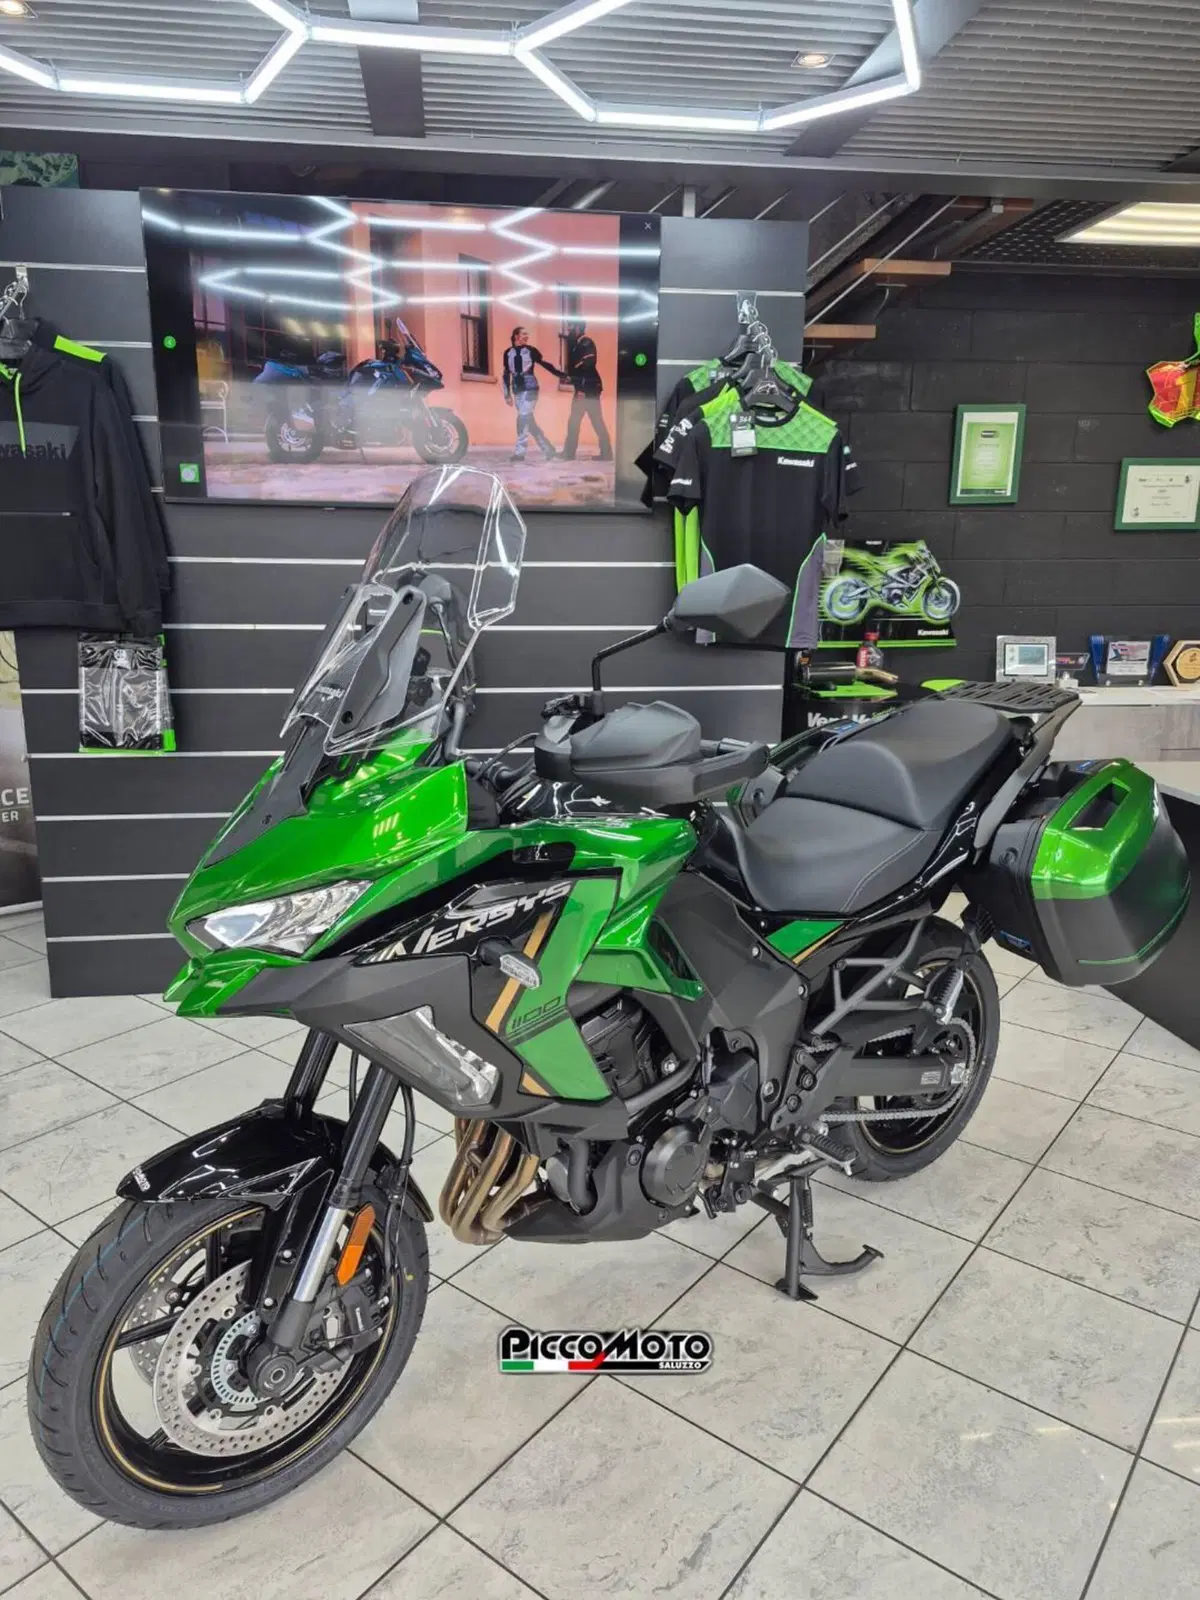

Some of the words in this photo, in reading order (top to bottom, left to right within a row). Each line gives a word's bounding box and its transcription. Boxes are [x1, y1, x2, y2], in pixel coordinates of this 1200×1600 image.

[917, 629, 949, 637] Kawasaki
[1, 787, 30, 806] CE
[1, 811, 19, 823] ER
[385, 881, 572, 957] VERSYS
[511, 996, 561, 1029] 1100
